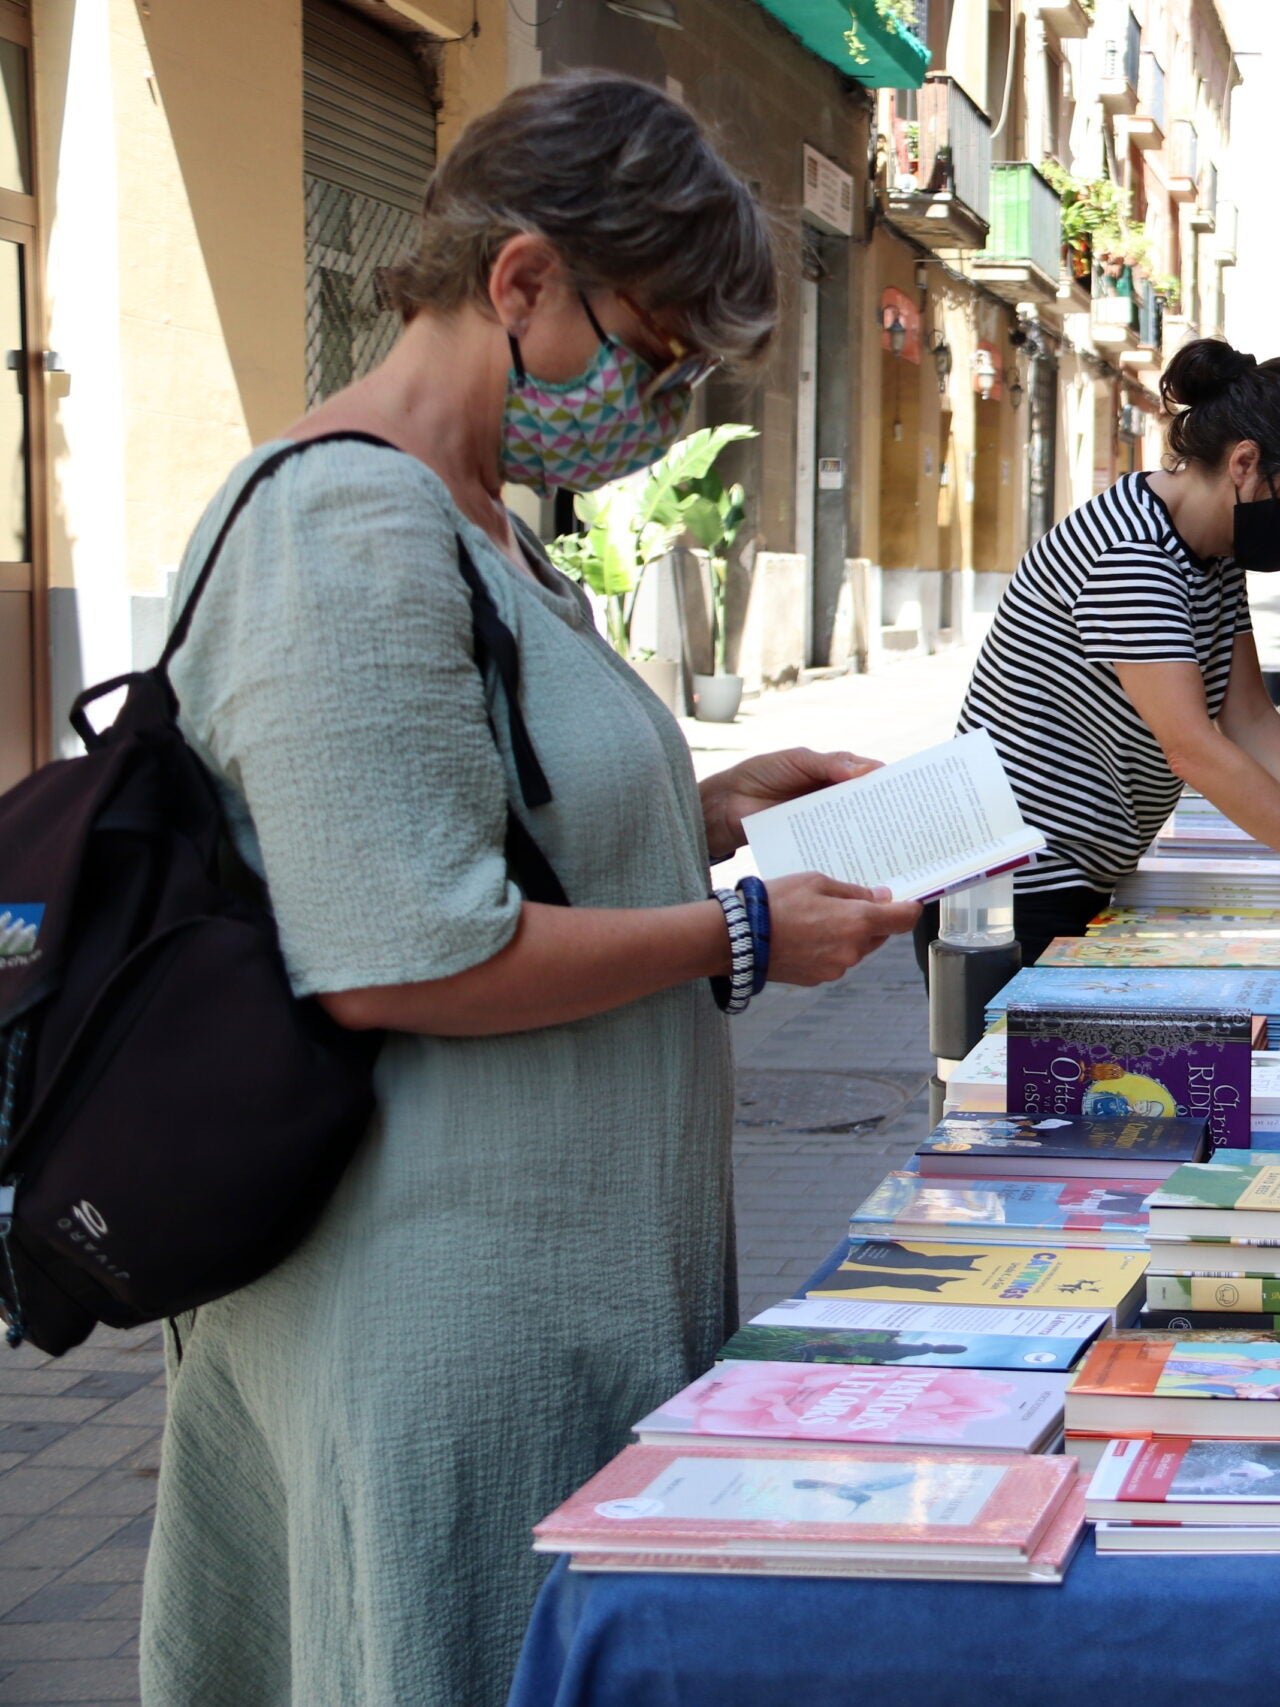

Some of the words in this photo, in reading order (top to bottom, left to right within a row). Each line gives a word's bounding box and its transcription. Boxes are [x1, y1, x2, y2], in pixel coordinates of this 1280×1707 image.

[998, 1252, 1059, 1300] CATWINGS
[797, 1379, 879, 1425] FLORS
[848, 1372, 941, 1430] VIATGES
